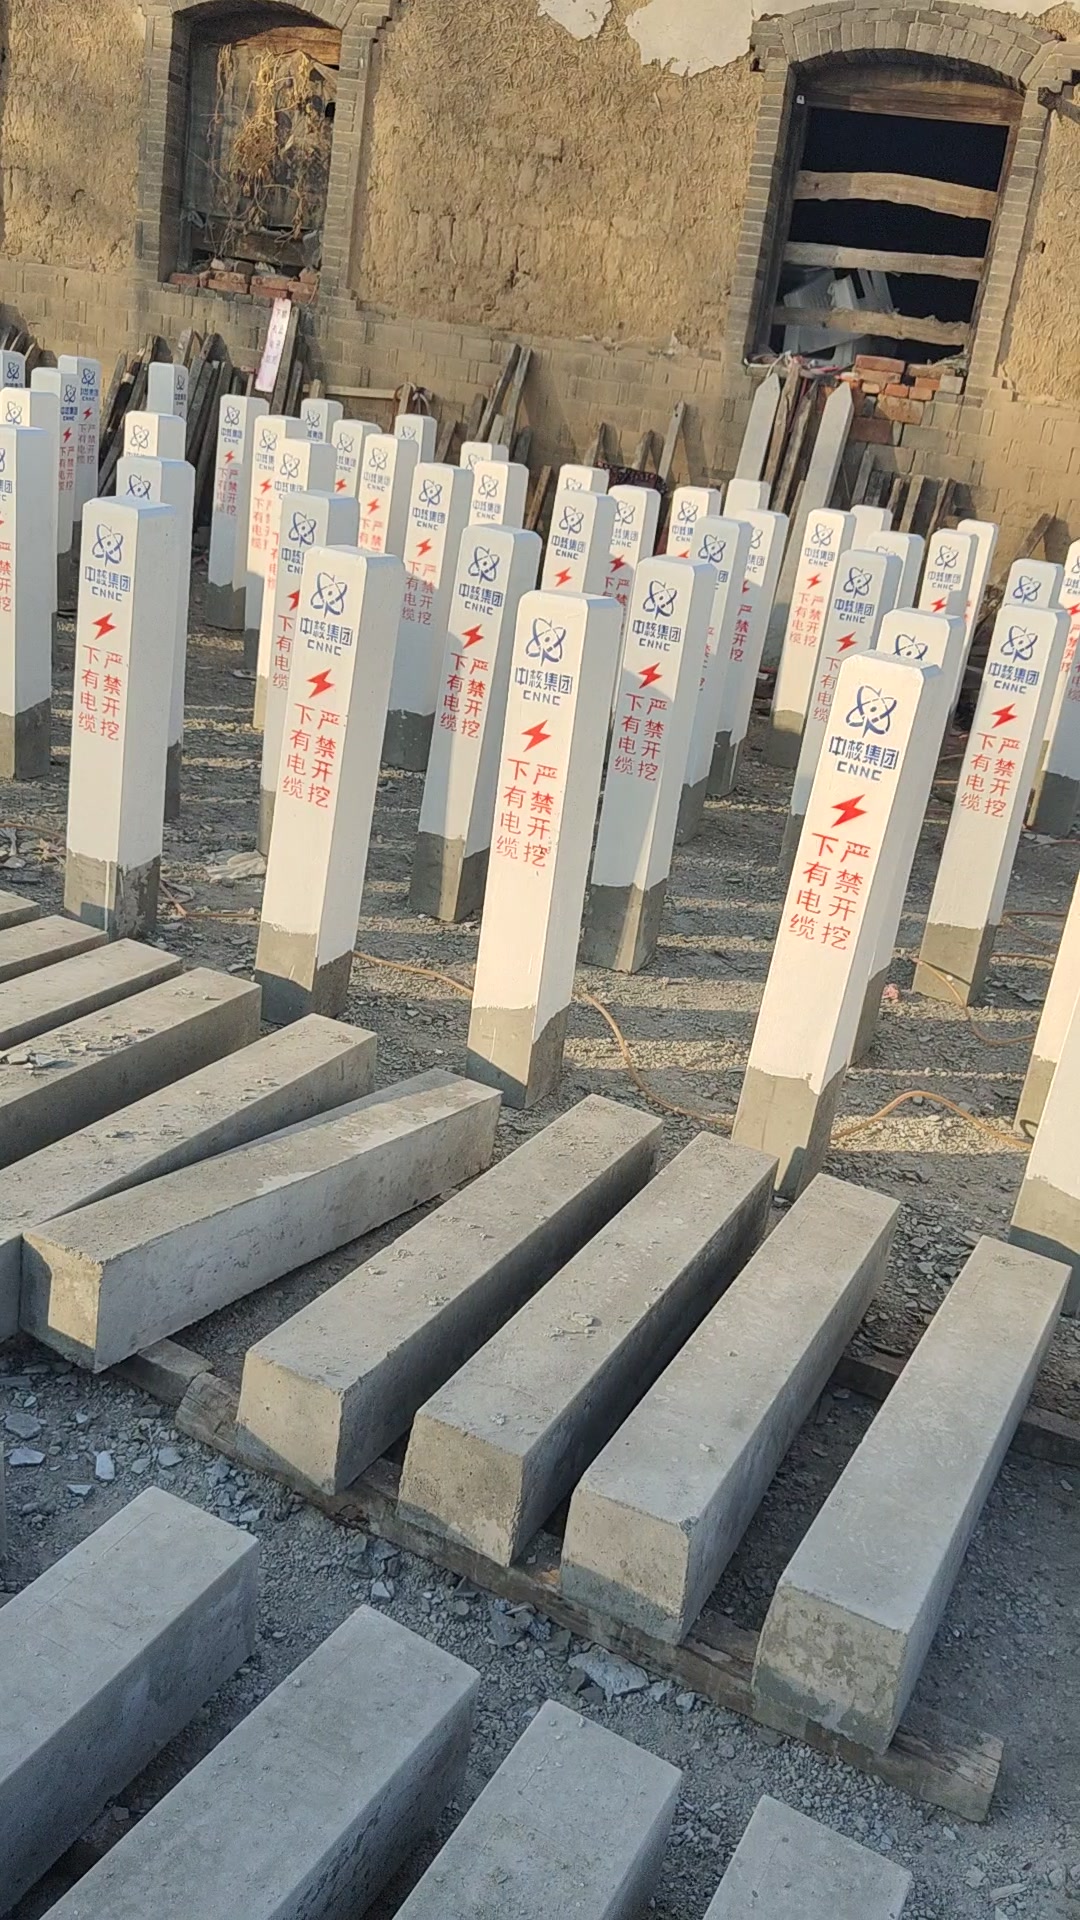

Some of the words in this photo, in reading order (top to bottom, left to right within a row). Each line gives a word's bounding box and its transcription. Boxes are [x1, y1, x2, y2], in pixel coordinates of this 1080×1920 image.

[367, 483, 385, 492] CNNC
[412, 507, 446, 524] 中核集团
[416, 521, 439, 531] CNNC
[476, 511, 496, 520] CNNC
[555, 549, 579, 560] CNNC
[808, 558, 829, 567] CNNC
[85, 565, 131, 592] 中核集团
[402, 561, 421, 622] 下有电缆
[931, 582, 954, 590] CNNC
[91, 585, 123, 602] CNNC
[417, 564, 437, 625] 严禁开挖
[459, 583, 504, 608] 中核集团
[464, 600, 494, 616] CNNC
[834, 598, 875, 617] 中核集团
[300, 617, 353, 647] 中核集团
[632, 619, 681, 643] 中核集团
[803, 595, 824, 647] 严禁开挖
[839, 612, 866, 624] CNNC
[272, 614, 295, 690] 下有电缆
[307, 639, 342, 656] CNNC
[639, 637, 671, 652] CNNC
[515, 667, 573, 695] 中核集团
[988, 662, 1040, 686] 中核集团
[993, 679, 1028, 695] CNNC
[78, 645, 101, 734] 下有电缆
[100, 651, 124, 741] 严禁开挖
[439, 652, 468, 732] 下有电缆
[461, 658, 489, 739] 严禁开挖
[522, 690, 561, 706] CNNC
[813, 656, 841, 722] 下有电缆
[614, 692, 645, 775] 下有电缆
[637, 697, 667, 781] 严禁开挖
[282, 703, 315, 800] 下有电缆
[307, 709, 341, 808] 严禁开挖
[828, 735, 900, 770] 中核集团
[836, 760, 882, 781] CNNC
[960, 731, 997, 812] 下有电缆
[984, 736, 1022, 818] 严禁开挖
[496, 758, 531, 860] 下有电缆
[523, 764, 558, 868] 严禁开挖
[788, 832, 839, 942] 下有电缆
[821, 841, 871, 950] 严禁开挖
